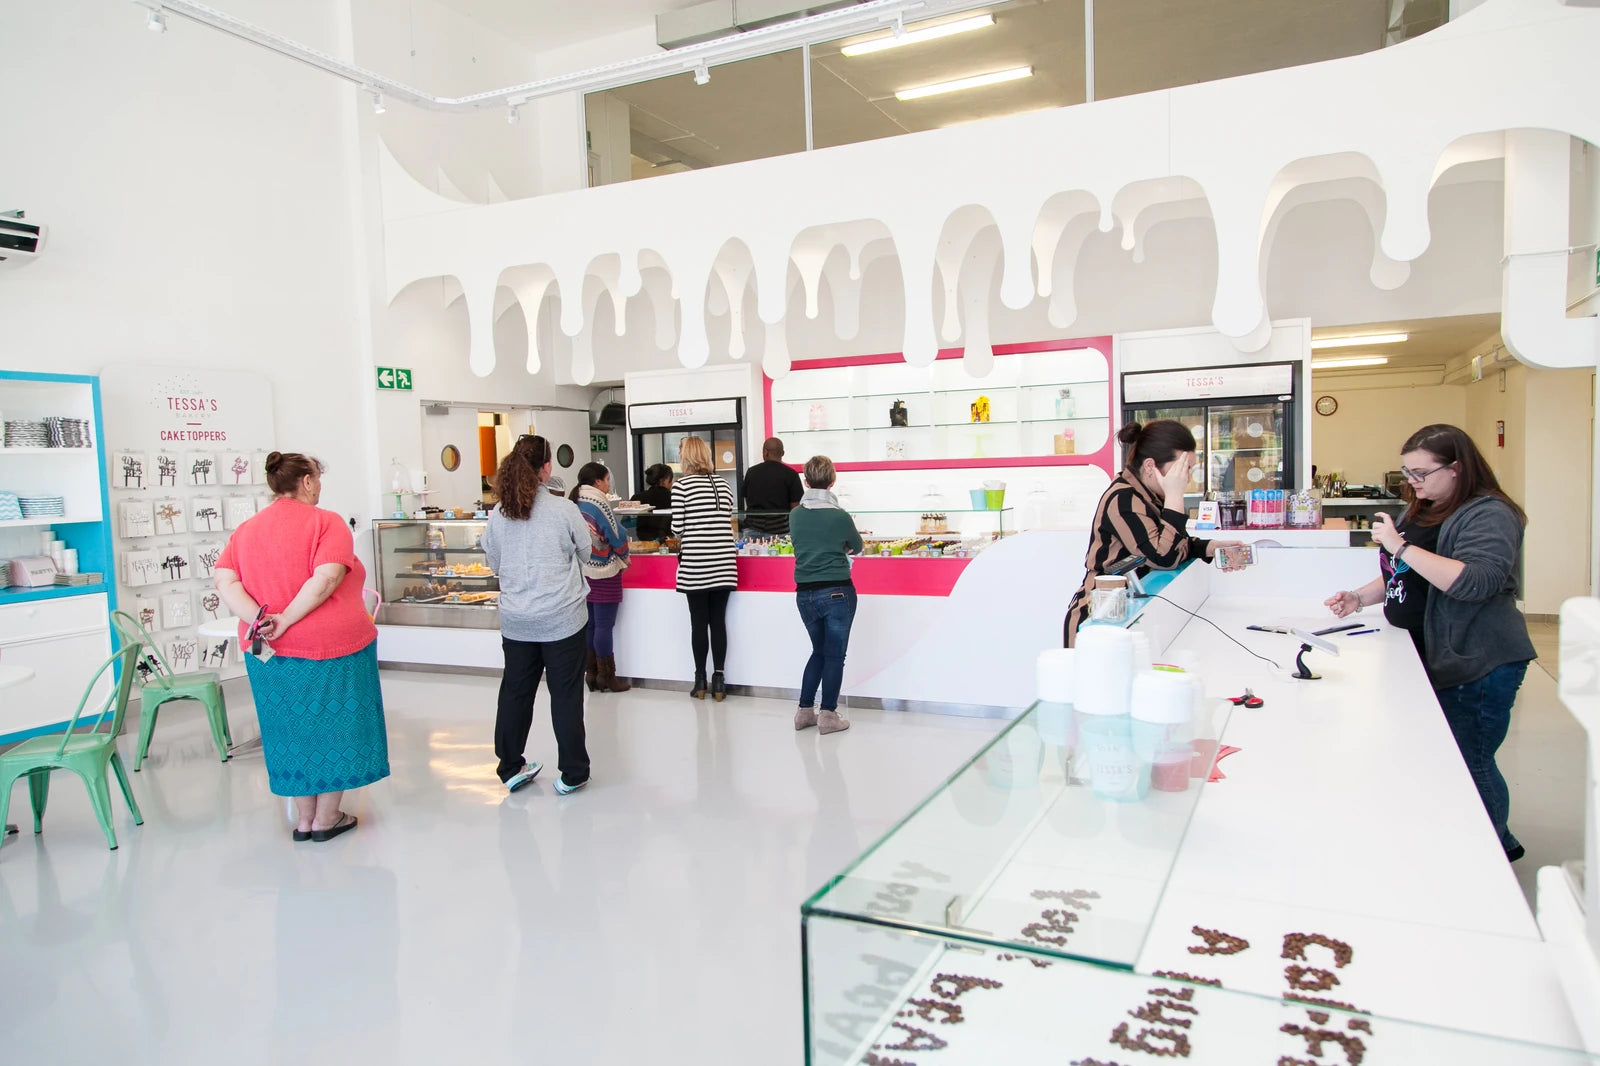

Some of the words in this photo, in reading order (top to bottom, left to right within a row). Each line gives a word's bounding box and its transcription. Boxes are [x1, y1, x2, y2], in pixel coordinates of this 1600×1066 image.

[1185, 376, 1224, 387] TESSA'S
[167, 397, 218, 411] TESSA'S
[669, 408, 694, 417] TESSA'S
[160, 430, 186, 441] CAKE
[186, 430, 227, 441] TOPPERS
[1187, 925, 1250, 957] A
